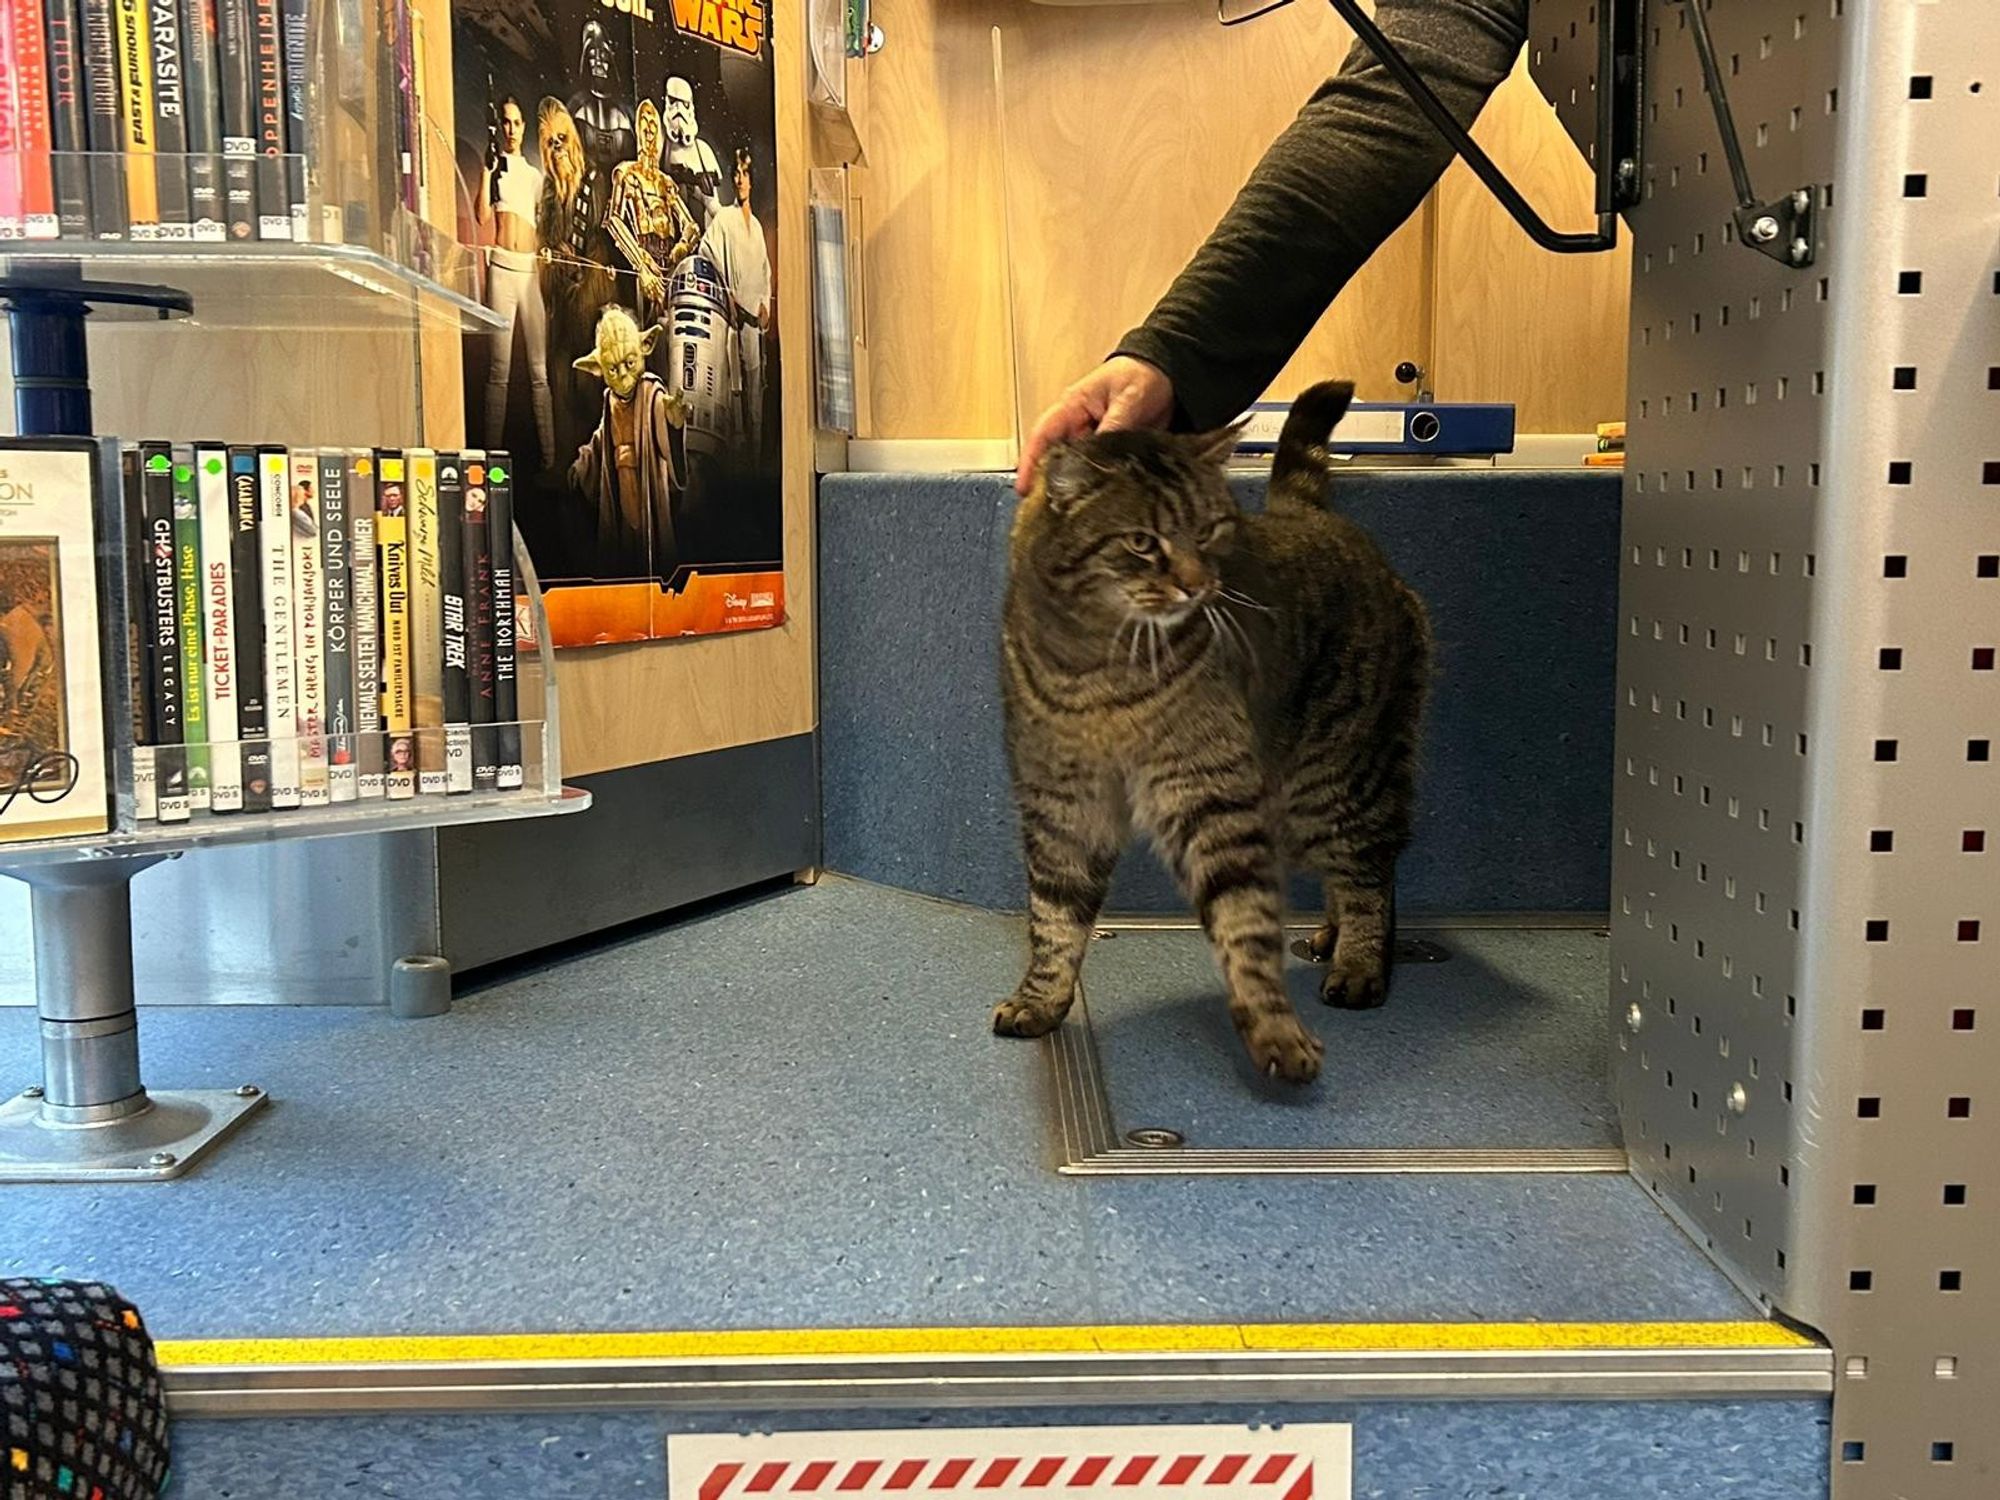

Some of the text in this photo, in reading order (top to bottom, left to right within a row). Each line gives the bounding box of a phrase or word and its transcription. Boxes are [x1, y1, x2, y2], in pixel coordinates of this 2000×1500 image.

[50, 19, 74, 106] THOR
[125, 14, 142, 87] FURIOUS
[672, 0, 763, 53] WARS
[130, 98, 147, 145] FAST
[226, 140, 250, 151] DVD
[180, 544, 196, 581] Hase
[324, 467, 346, 654] KÖRPER UND SEELE
[387, 540, 407, 614] Knives Out
[210, 561, 229, 637] PARADIES
[271, 545, 290, 719] THE GENTLEMEN
[353, 518, 378, 734] NIEMALS SELTEN MANCHMAL IMMER
[444, 594, 466, 670] STAR TREK
[477, 553, 493, 699] ANNE FRANK
[494, 568, 514, 681] THE NORTHMAN
[163, 655, 176, 726] LEGACY
[212, 645, 232, 701] TICKET
[160, 801, 181, 811] DVD
[329, 769, 352, 780] DVD
[387, 776, 410, 788] DVD
[476, 766, 497, 774] DVD
